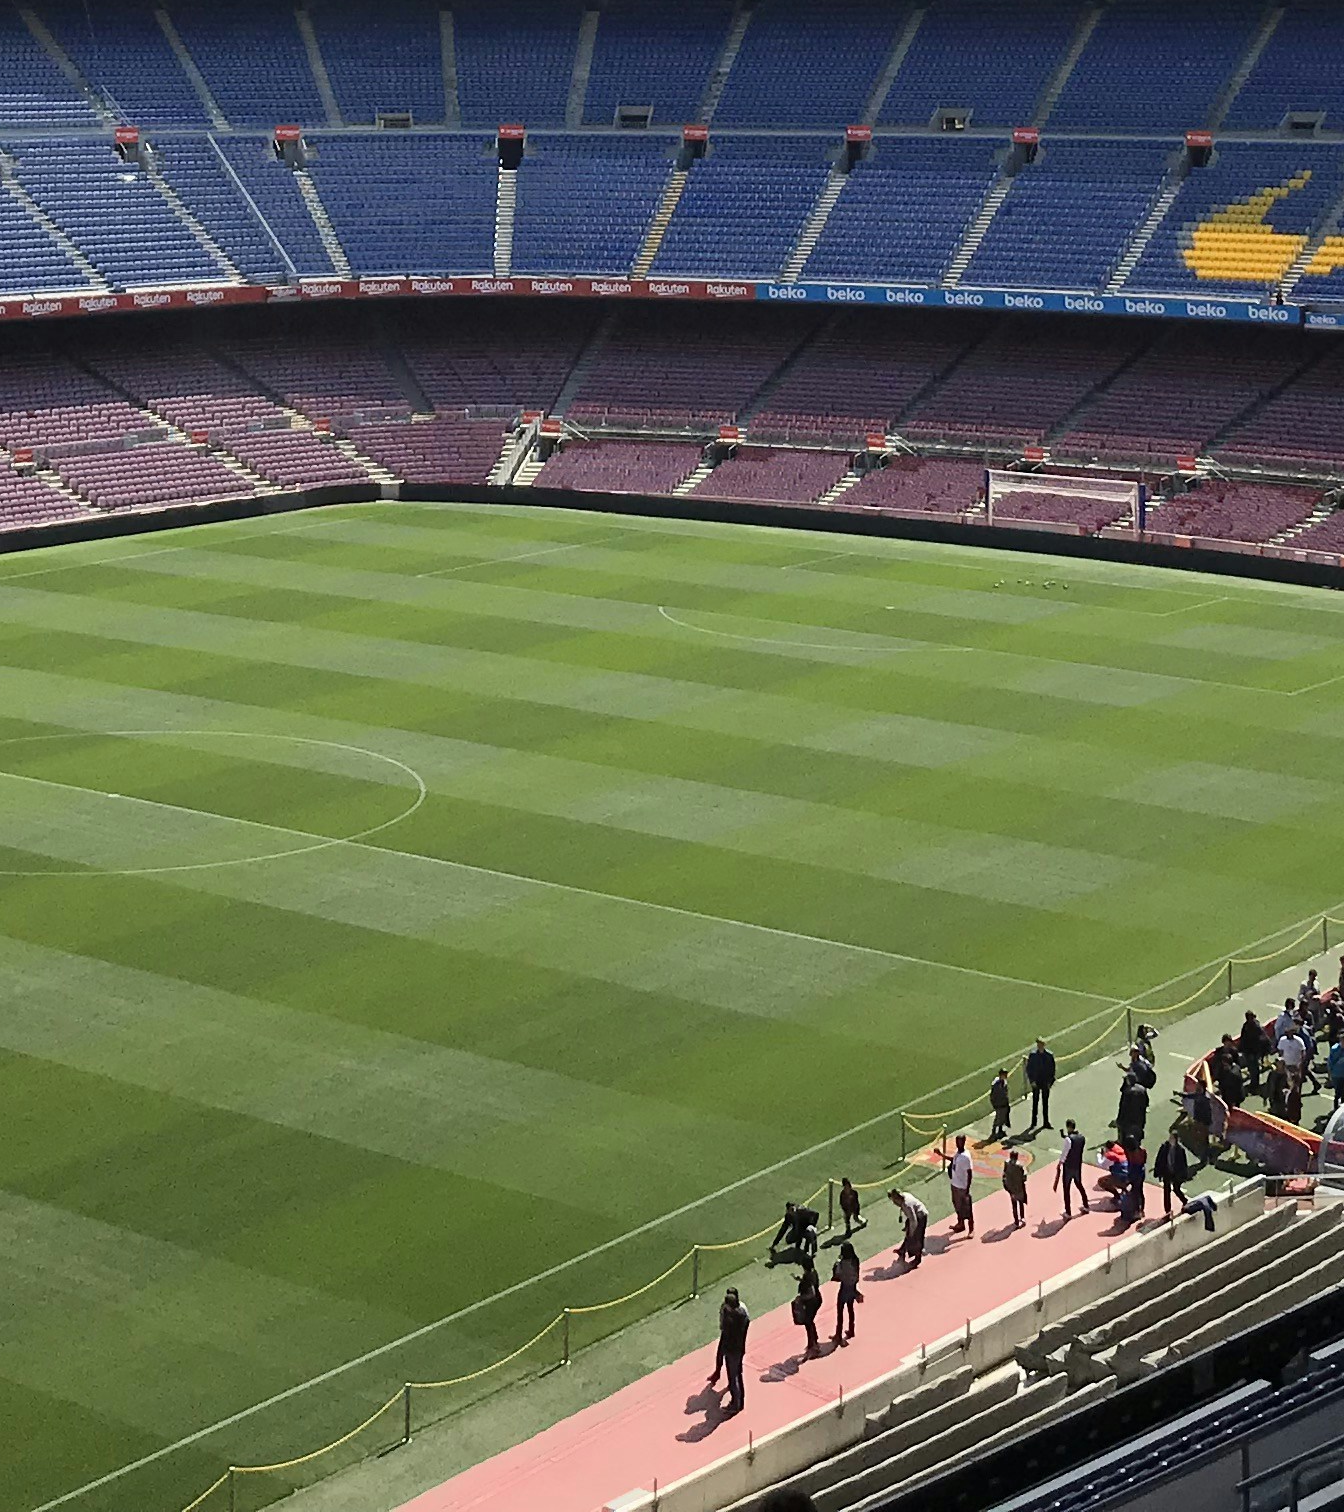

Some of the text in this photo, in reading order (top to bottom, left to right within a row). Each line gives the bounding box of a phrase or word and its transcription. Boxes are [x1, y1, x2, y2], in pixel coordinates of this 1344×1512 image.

[301, 283, 342, 294] Rakuten
[359, 281, 400, 293] Rakuten
[412, 280, 453, 291] Rakuten
[471, 280, 513, 291] Rakuten
[531, 280, 573, 292] Rakuten
[591, 280, 632, 293] Rakuten
[648, 282, 689, 294] Rakuten
[706, 284, 747, 295] Rakuten
[768, 285, 807, 299] beko
[134, 293, 171, 305] Rakuten
[187, 290, 224, 302] Rakuten
[827, 287, 865, 301] beko
[886, 289, 924, 303] beko
[944, 291, 983, 305] beko
[22, 300, 62, 313] Rakuten
[79, 296, 117, 309] Rakuten
[1004, 294, 1043, 308] beko
[1064, 296, 1104, 311] beko
[1125, 299, 1165, 314] beko
[1187, 302, 1226, 317] beko
[1248, 306, 1288, 321] beko
[1309, 315, 1336, 325] beko
